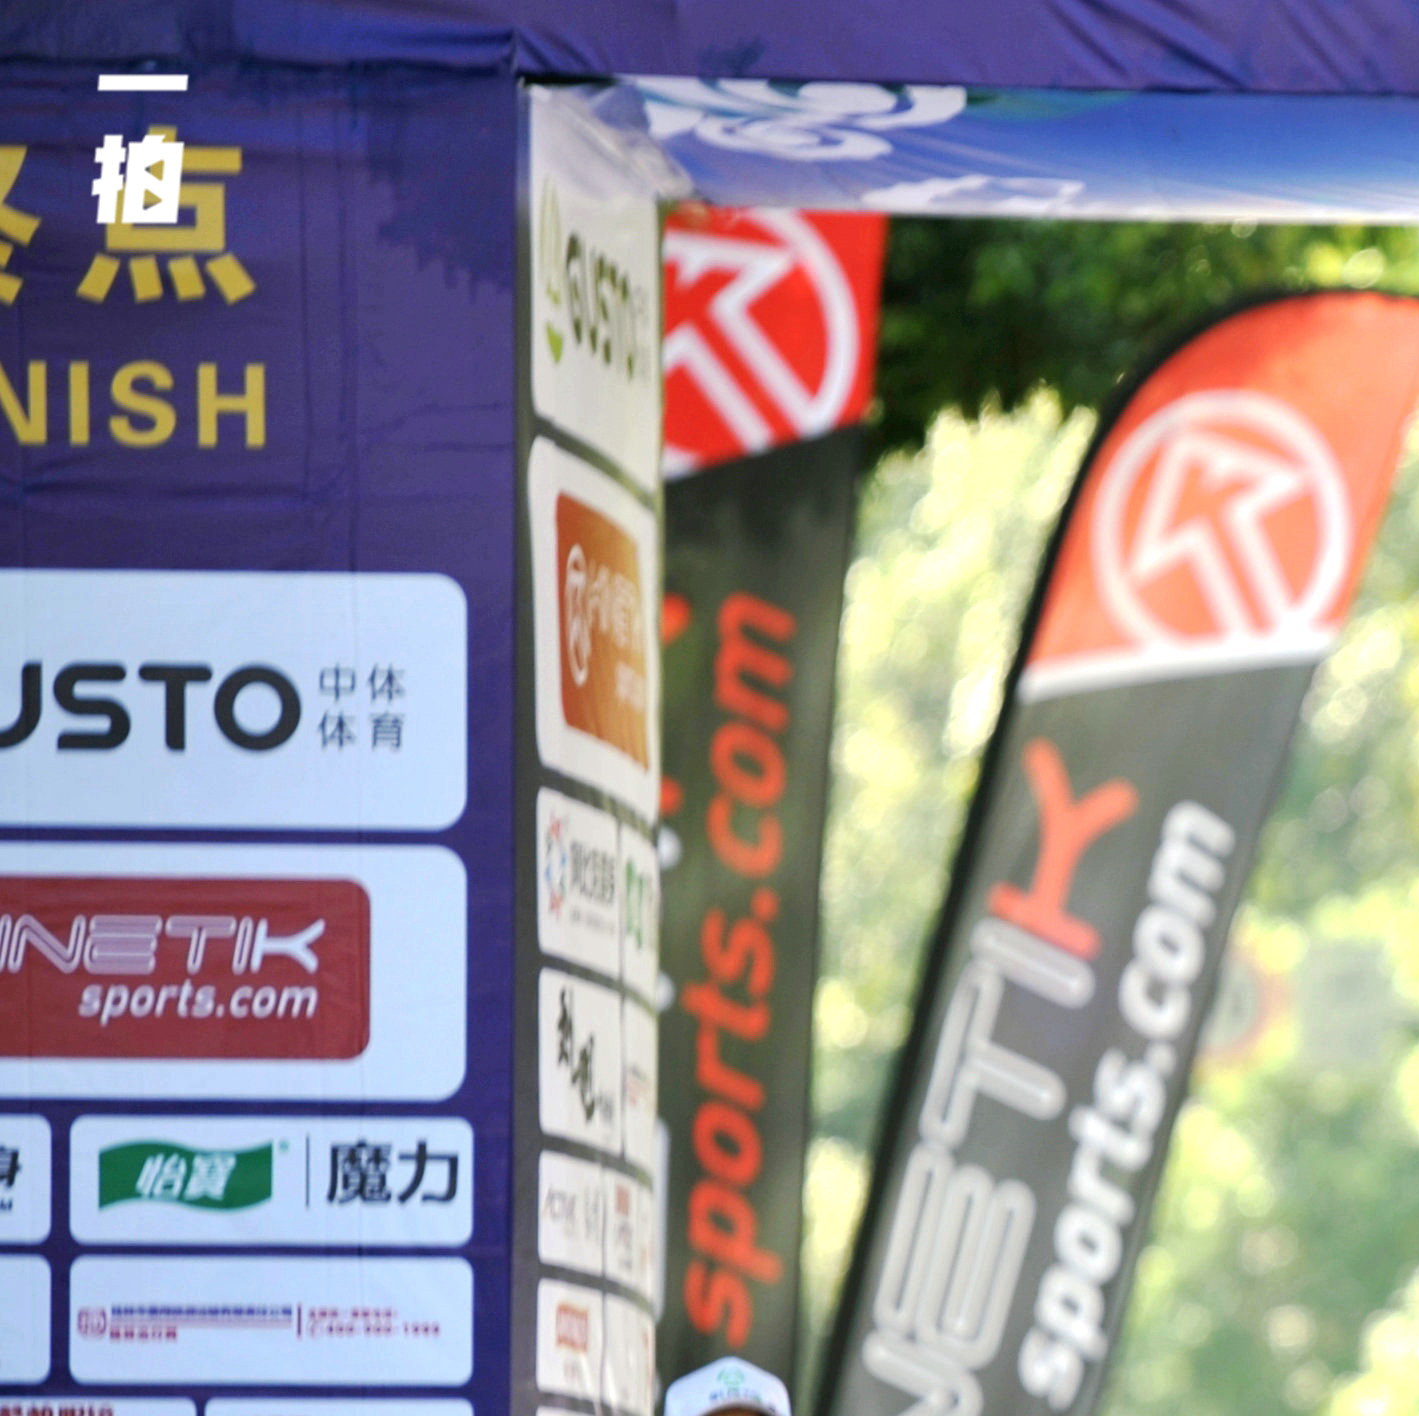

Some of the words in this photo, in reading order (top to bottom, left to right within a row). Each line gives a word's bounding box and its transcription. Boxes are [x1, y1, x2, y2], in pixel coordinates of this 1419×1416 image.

[78, 978, 319, 1026] sports.com
[682, 592, 796, 1348] sports.com
[1017, 800, 1236, 1411] sports.com
[326, 1139, 458, 1206] 魔力
